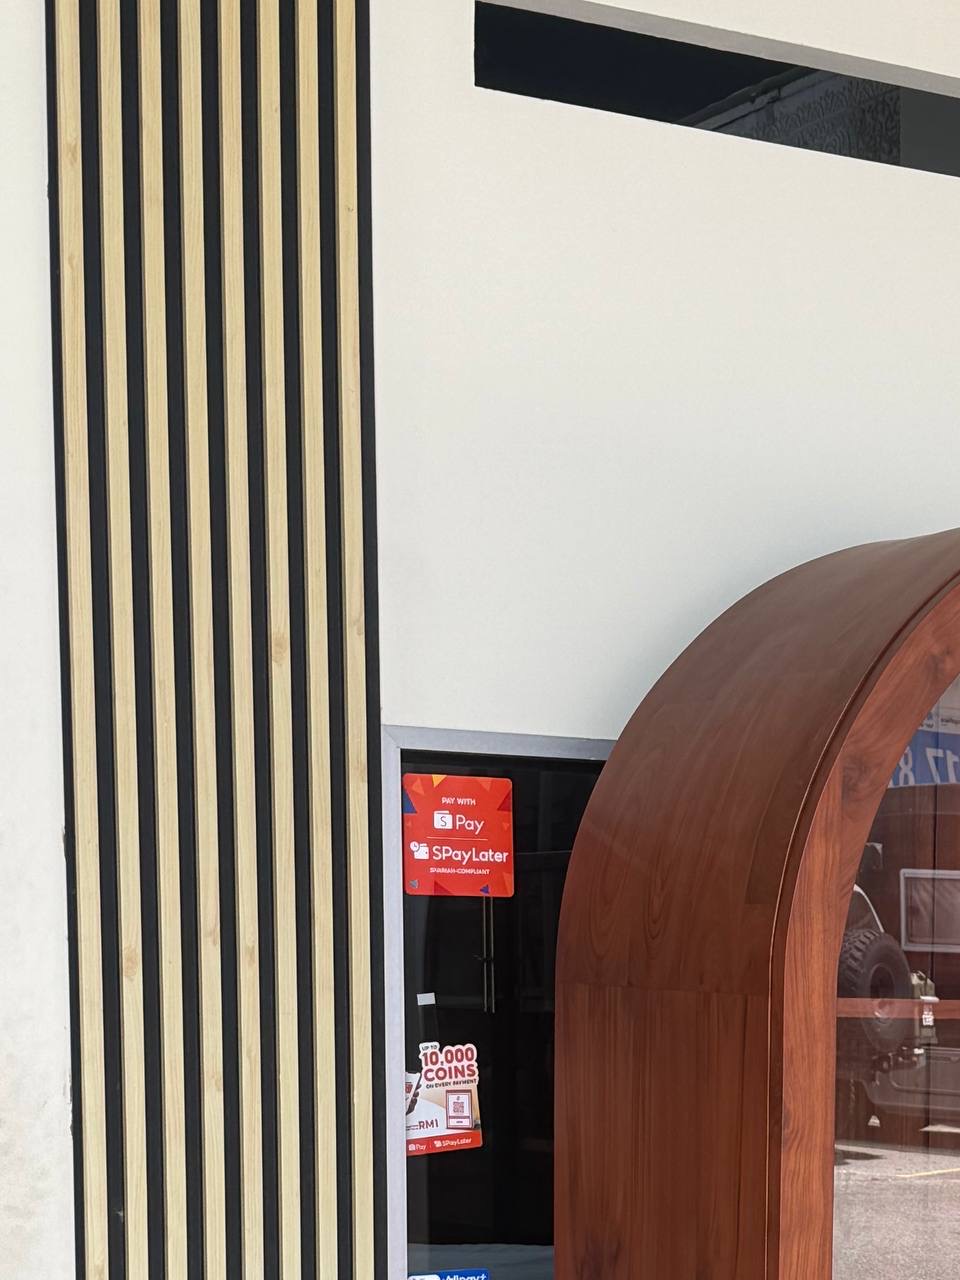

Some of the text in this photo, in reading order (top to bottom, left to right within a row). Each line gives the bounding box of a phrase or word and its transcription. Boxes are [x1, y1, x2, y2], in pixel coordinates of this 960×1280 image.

[441, 797, 476, 806] PAY WITH
[456, 814, 485, 835] Pay
[432, 846, 509, 866] SPayLater
[424, 1064, 476, 1082] COINS
